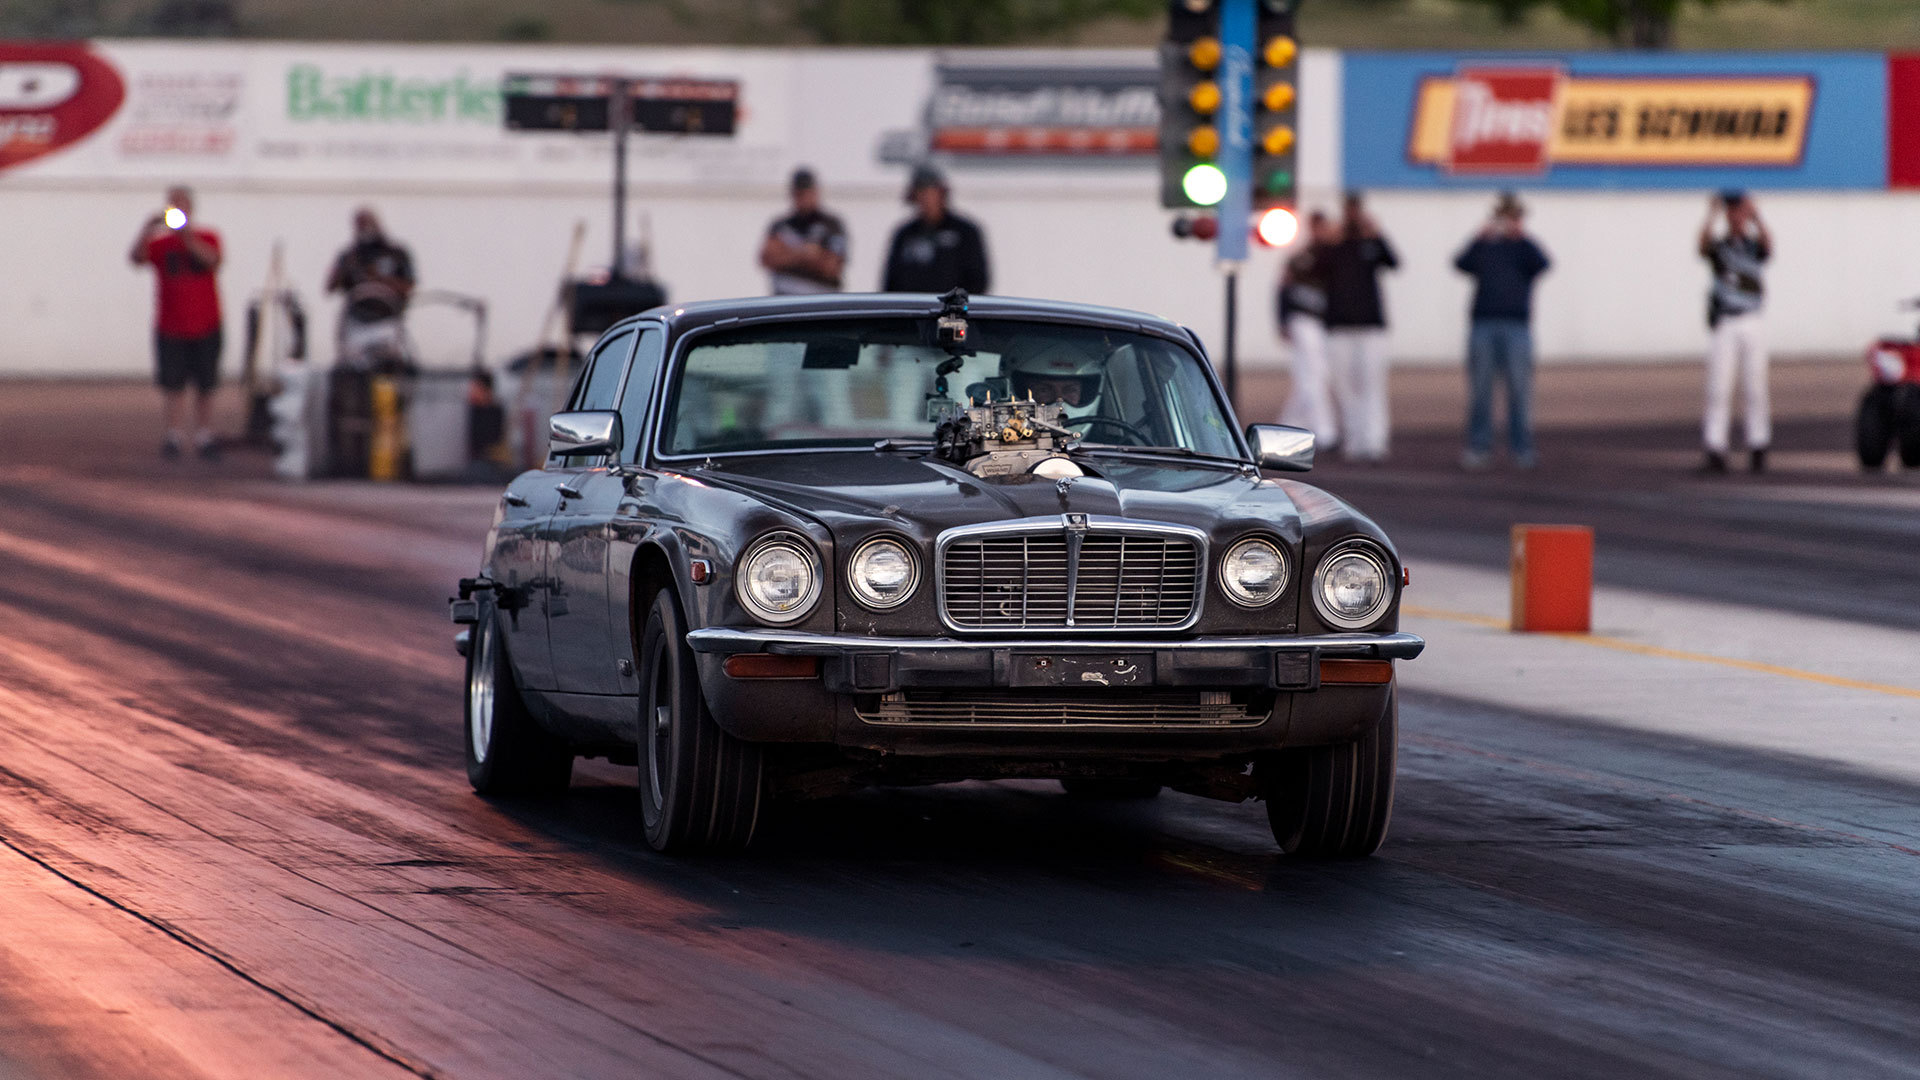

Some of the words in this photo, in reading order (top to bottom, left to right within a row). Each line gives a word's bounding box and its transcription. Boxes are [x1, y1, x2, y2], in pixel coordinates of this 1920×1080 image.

[286, 62, 506, 123] Batterie
[1562, 103, 1620, 139] LES
[1636, 102, 1791, 139] SCHWAB
